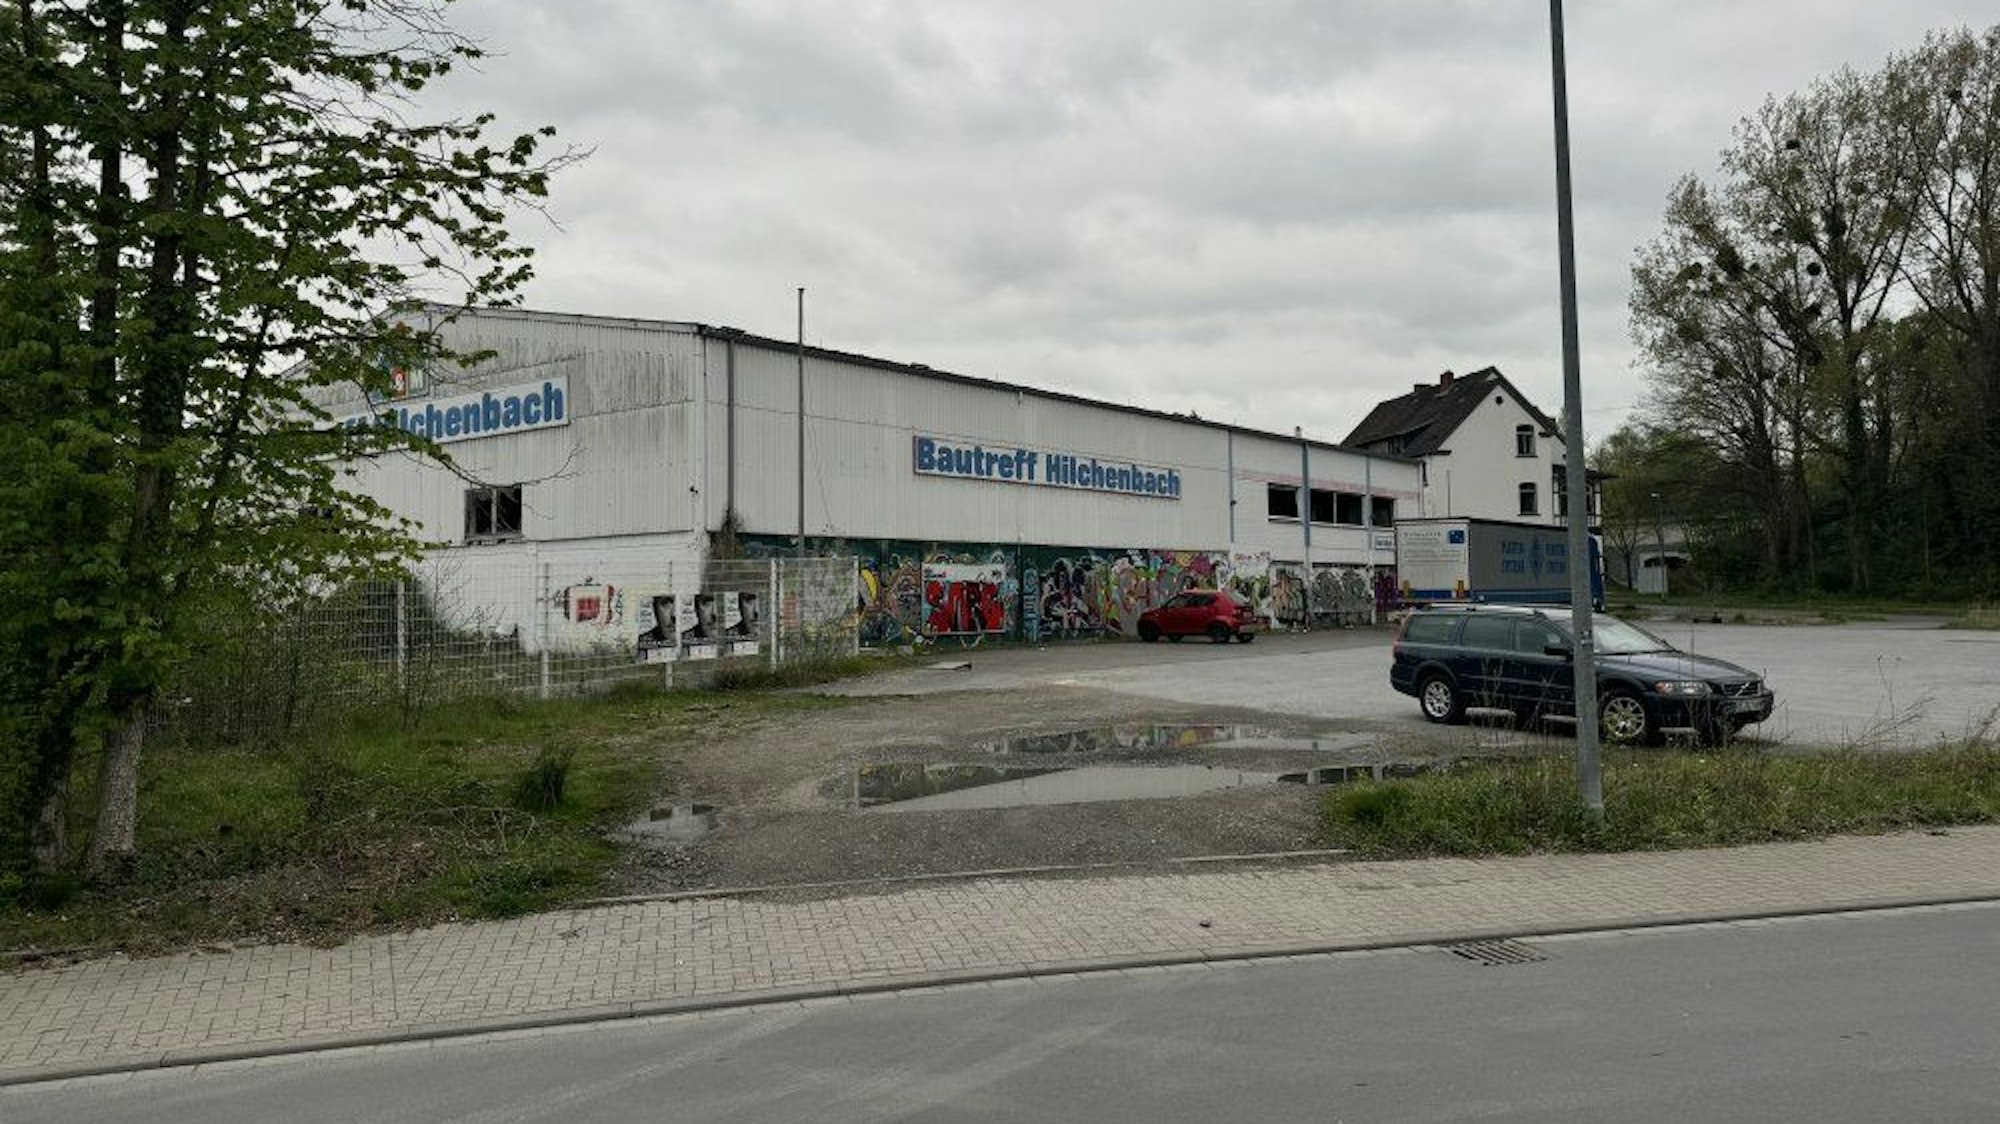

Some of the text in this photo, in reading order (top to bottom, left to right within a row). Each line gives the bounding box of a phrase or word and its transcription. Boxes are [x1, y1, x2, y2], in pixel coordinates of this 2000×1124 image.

[376, 381, 564, 440] lchenbach
[917, 438, 1181, 496] Bautreff Hilchenbach
